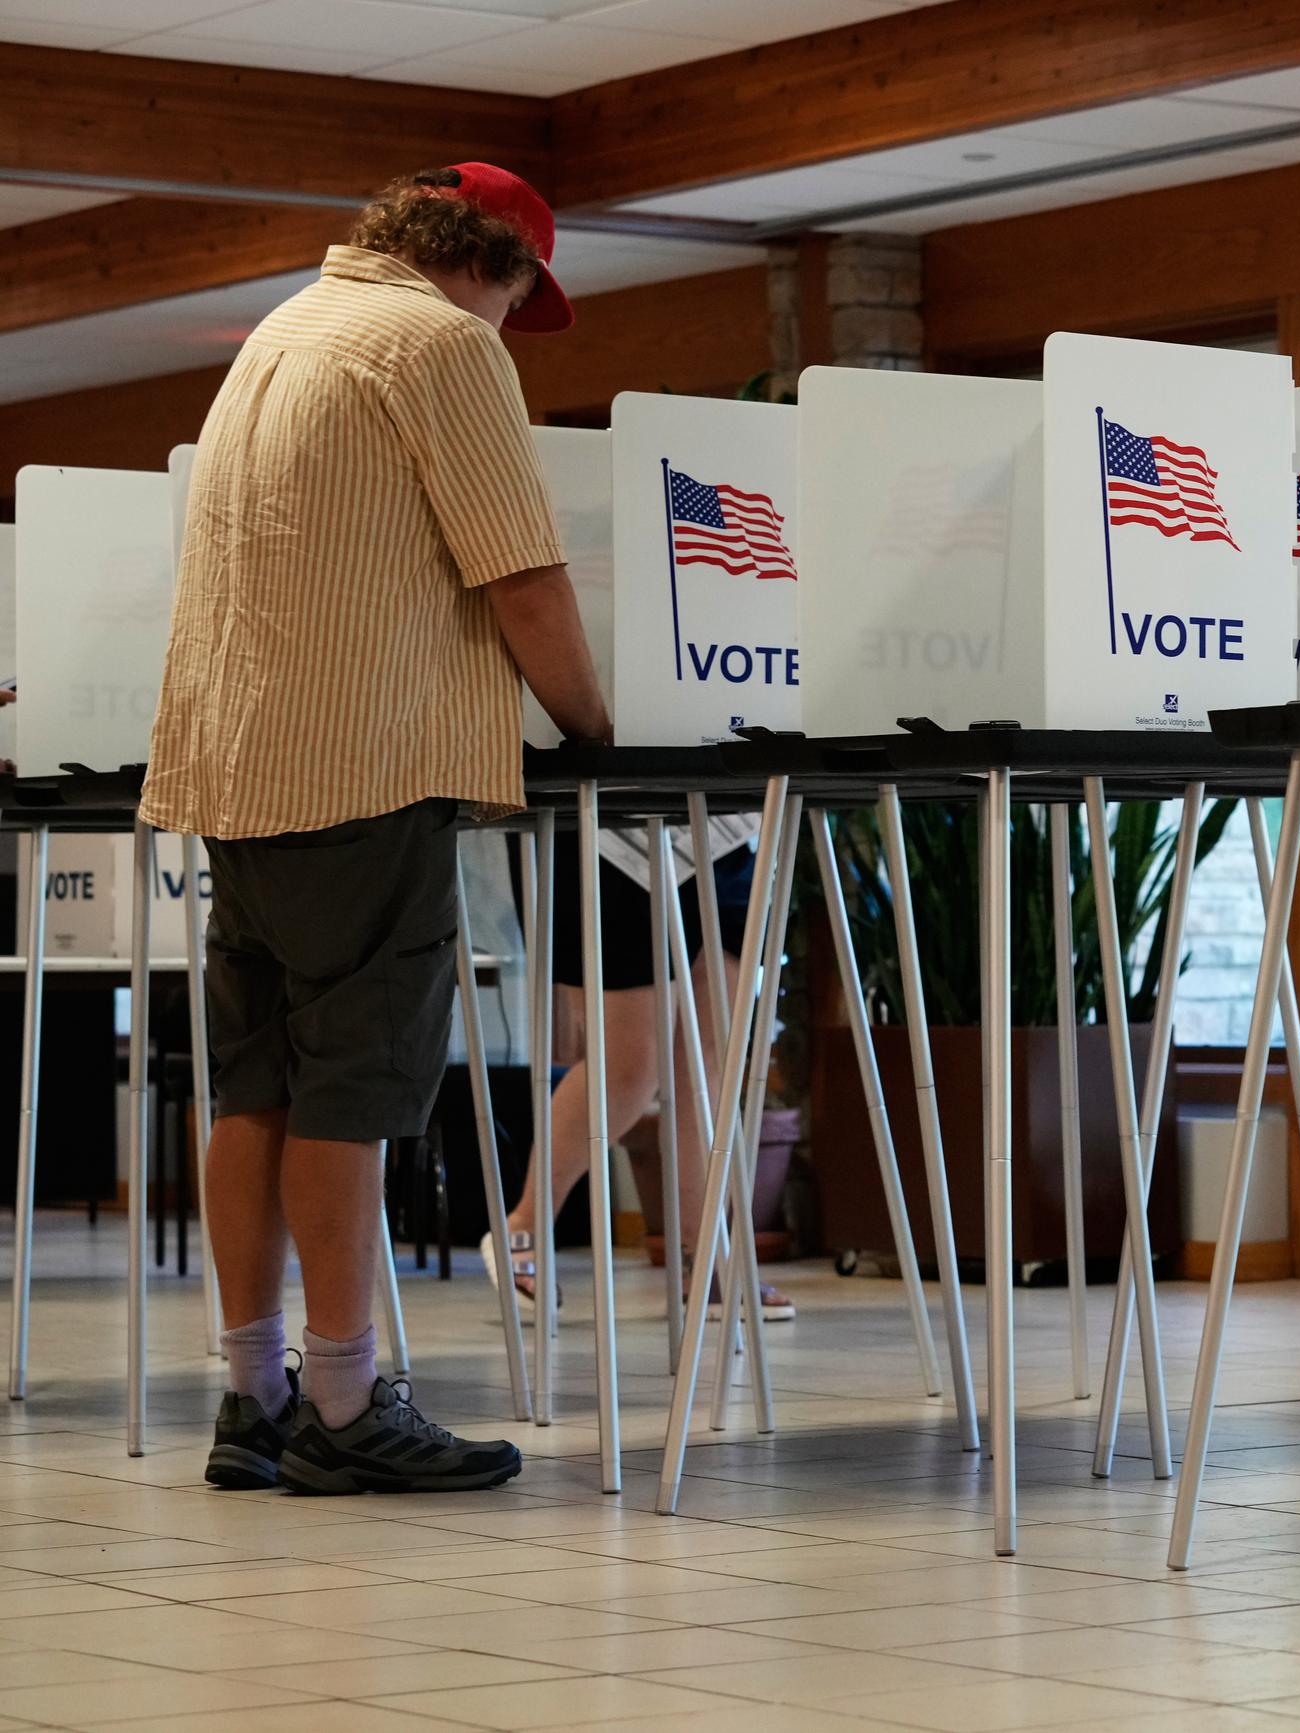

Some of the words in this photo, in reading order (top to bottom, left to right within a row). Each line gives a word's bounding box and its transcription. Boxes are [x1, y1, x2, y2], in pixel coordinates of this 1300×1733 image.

[1121, 612, 1244, 661] VOTE
[1135, 716, 1154, 725] Select
[1155, 717, 1167, 725] Duo
[1168, 718, 1187, 728] Voting
[1188, 718, 1205, 727] Booth
